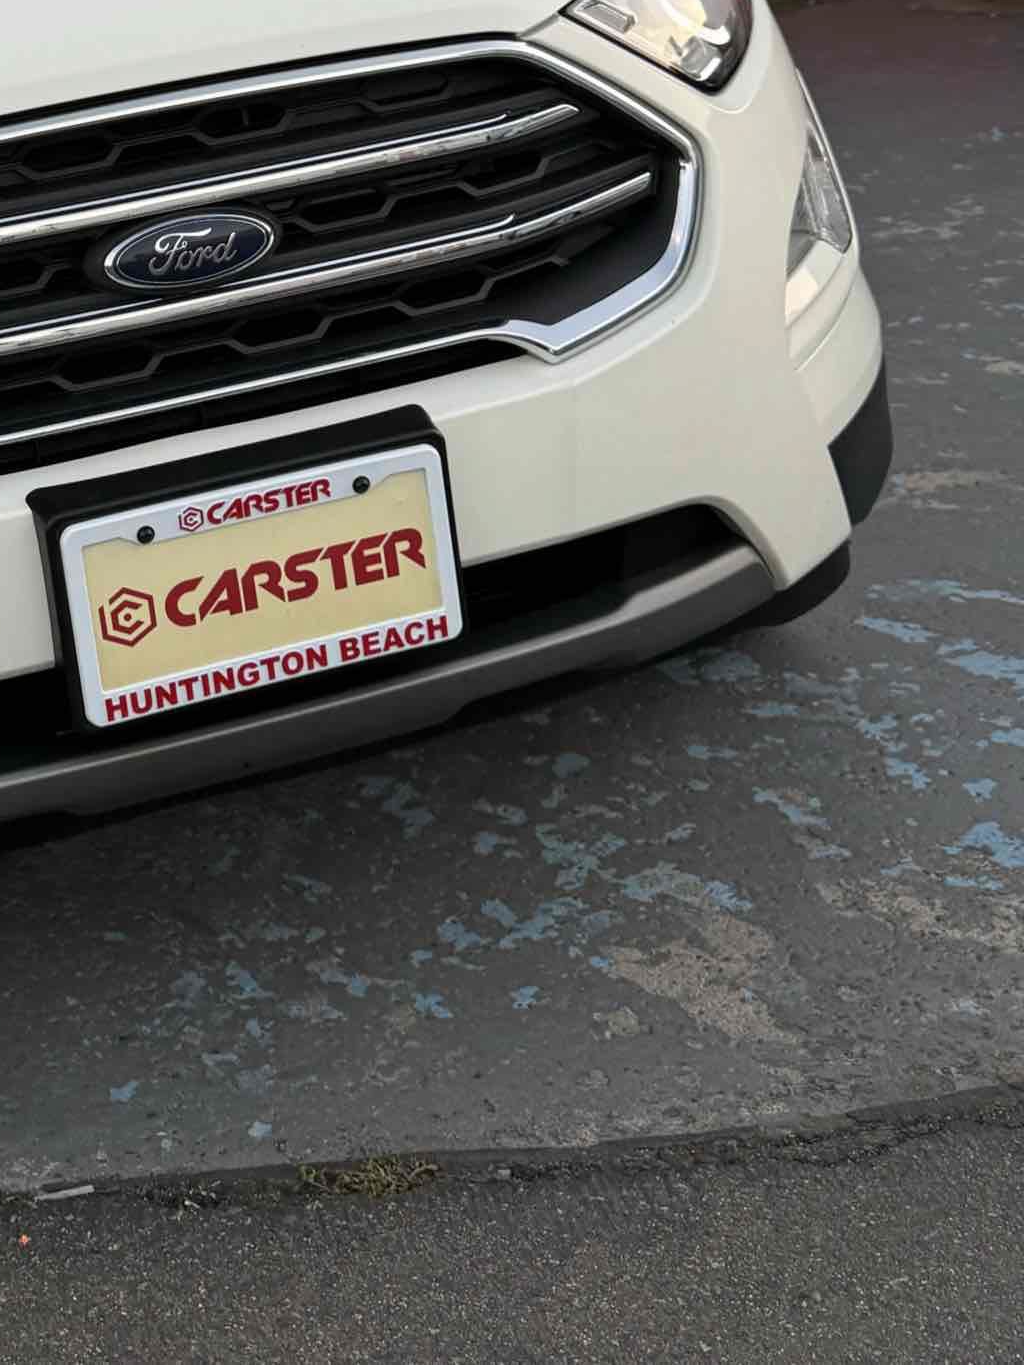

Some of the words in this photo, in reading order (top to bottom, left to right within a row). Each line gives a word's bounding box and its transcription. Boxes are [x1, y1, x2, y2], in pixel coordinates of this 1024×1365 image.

[148, 227, 238, 276] Ford
[206, 478, 331, 526] CARSTER
[164, 527, 426, 628] CARSTER
[104, 644, 329, 723] HUNTINGTON
[339, 614, 449, 662] BEACH
